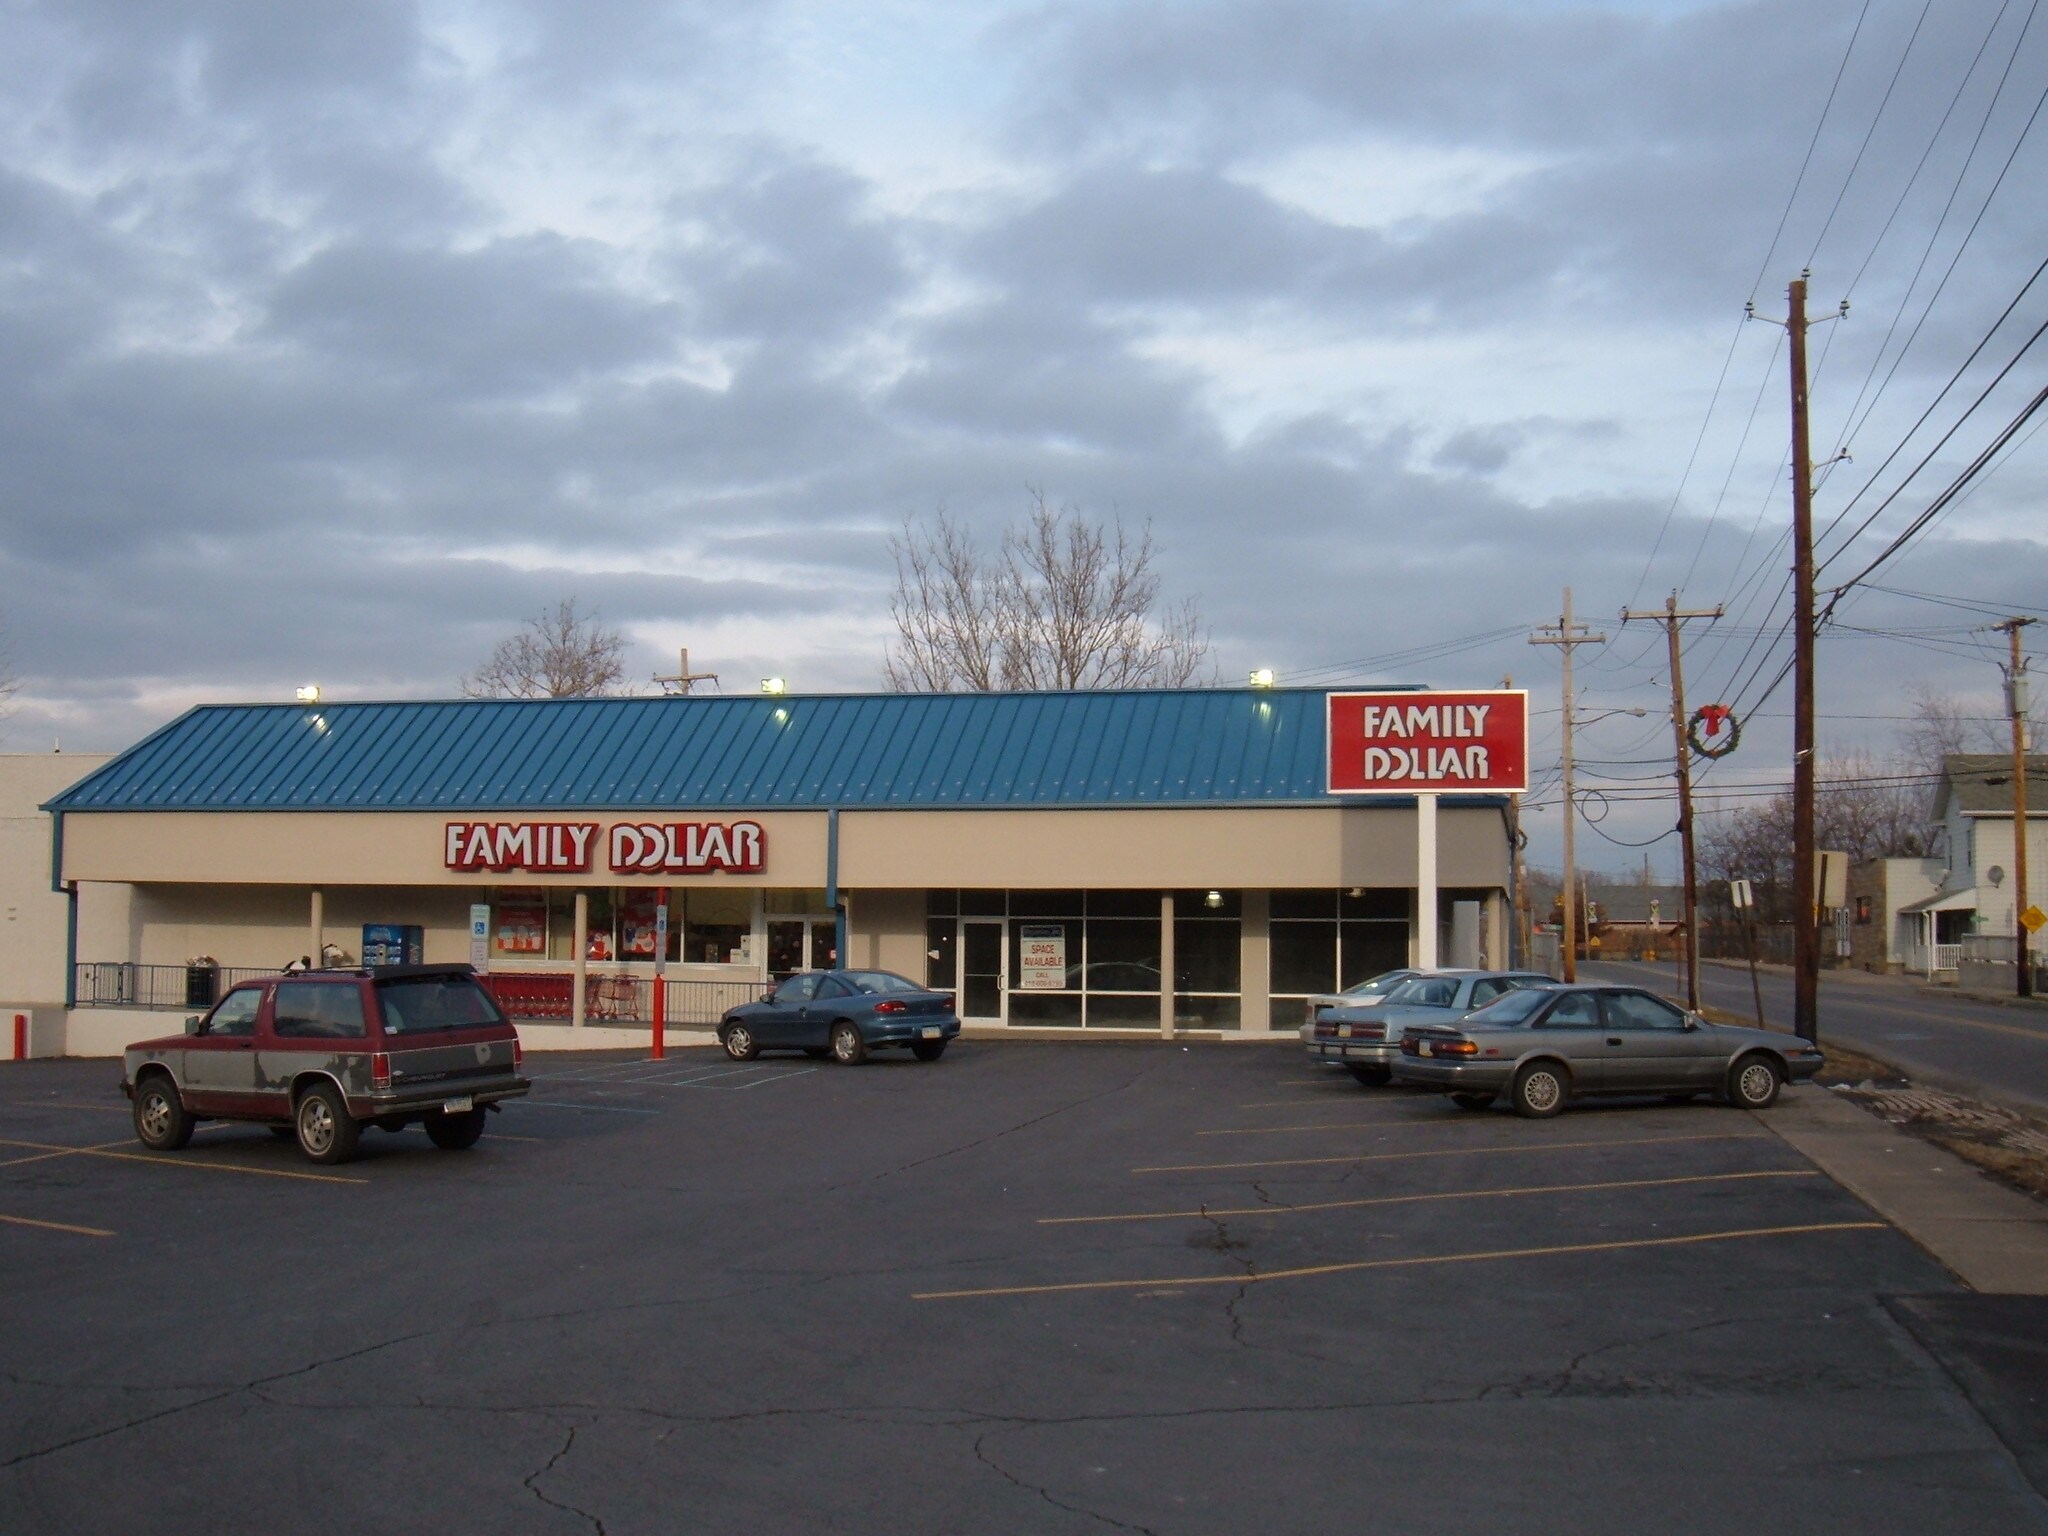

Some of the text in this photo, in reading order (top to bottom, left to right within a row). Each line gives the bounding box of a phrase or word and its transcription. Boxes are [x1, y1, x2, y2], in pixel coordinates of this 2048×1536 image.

[1364, 705, 1490, 738] FAMILY
[1364, 745, 1490, 780] DOLLAR
[446, 823, 761, 867] FAMILY DOLLAR
[1024, 957, 1063, 967] AVAILABLE
[1031, 944, 1055, 954] SPACE
